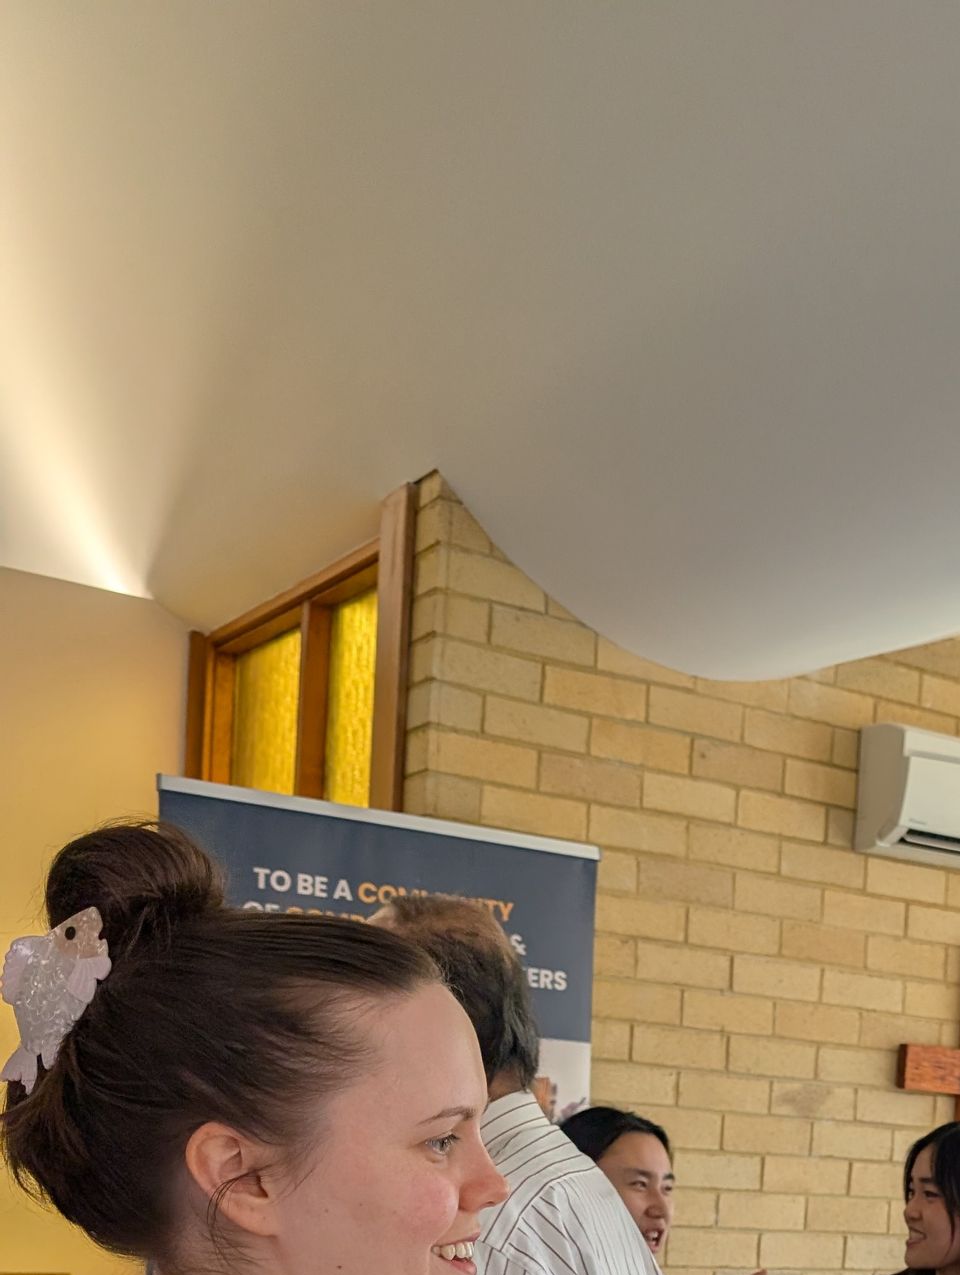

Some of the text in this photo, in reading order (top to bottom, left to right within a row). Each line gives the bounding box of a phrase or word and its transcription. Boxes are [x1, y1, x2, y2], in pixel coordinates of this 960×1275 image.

[252, 866, 292, 892] TO
[297, 873, 328, 898] BE
[333, 879, 353, 901] A
[526, 967, 567, 991] ERS
